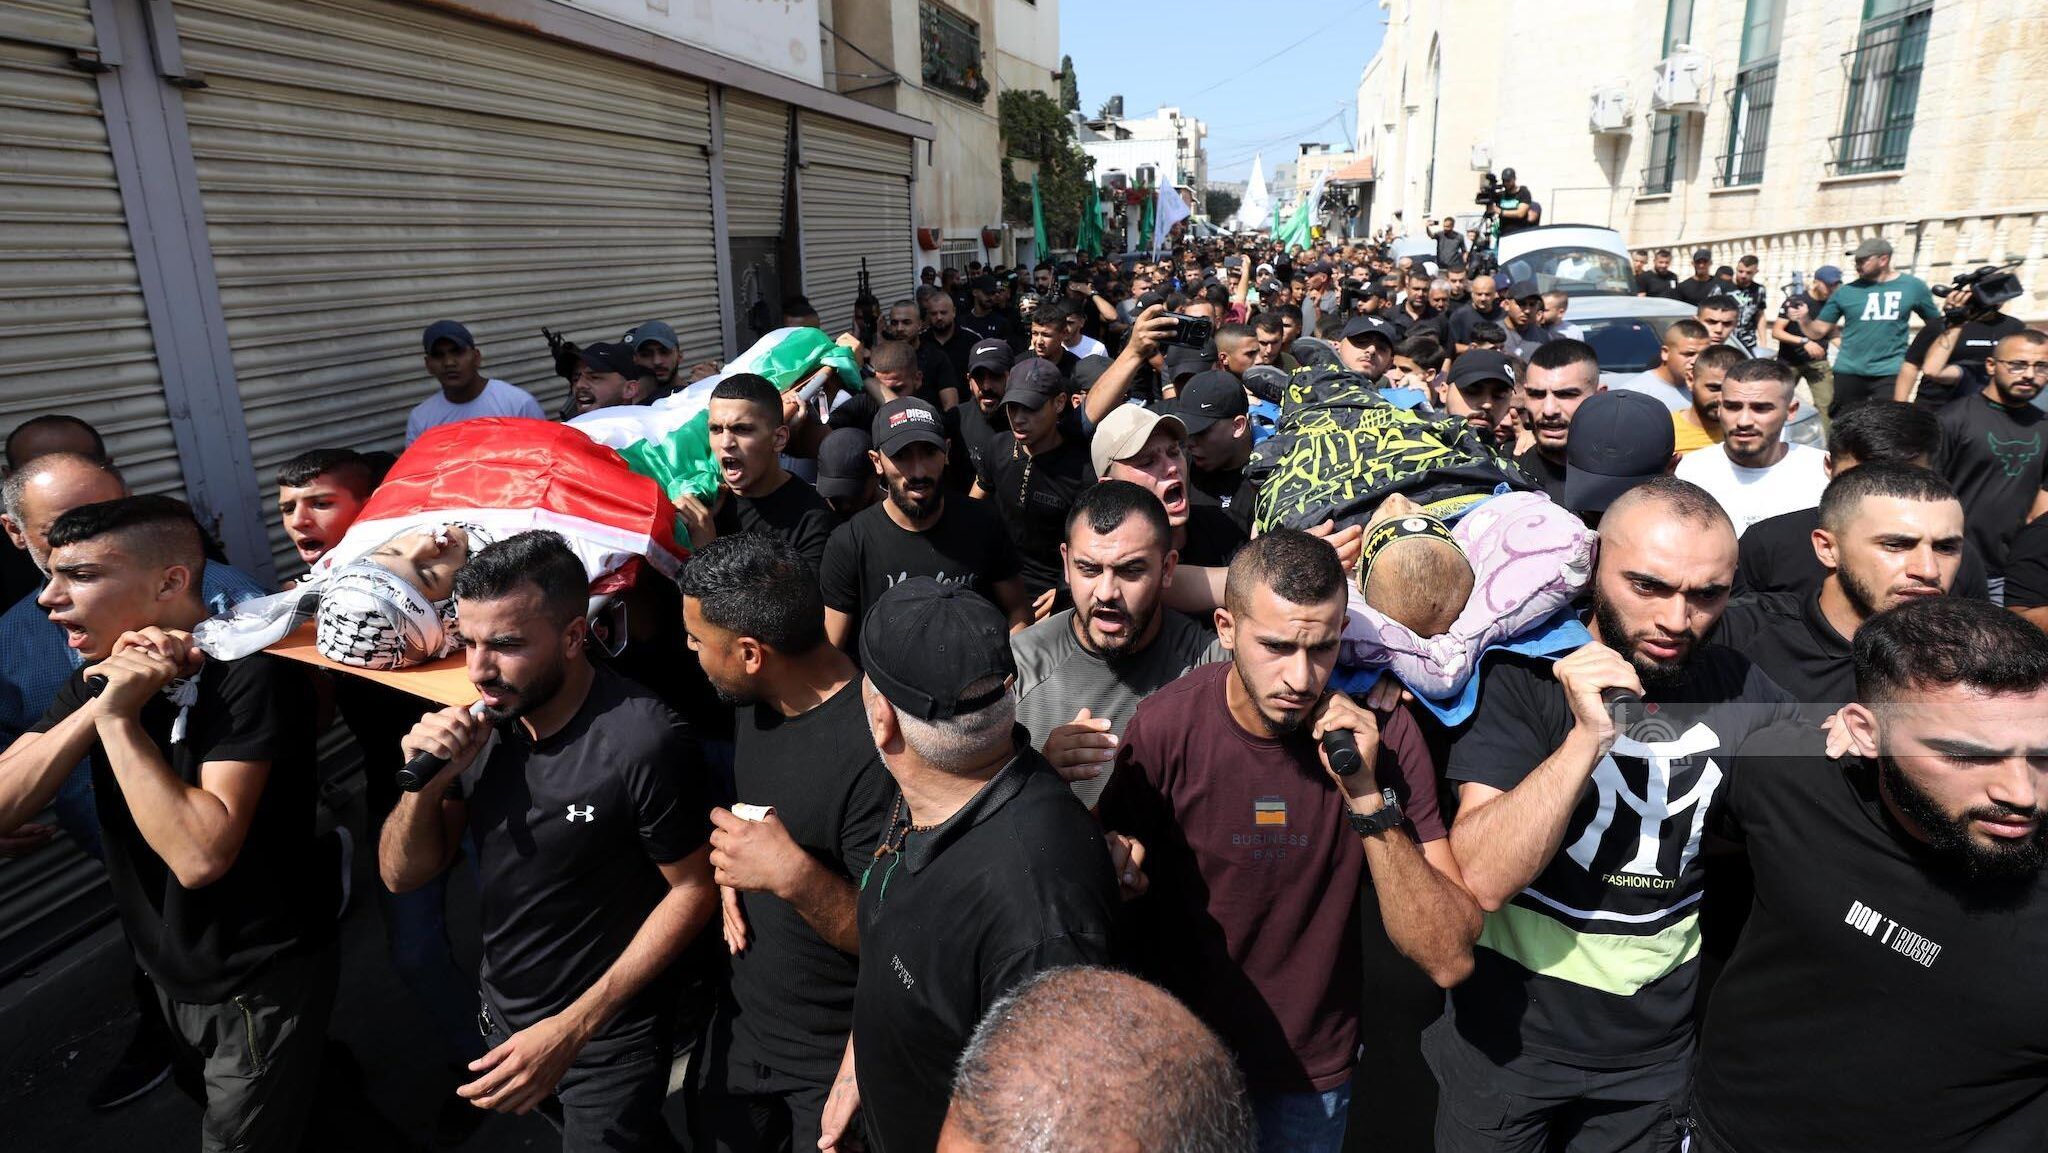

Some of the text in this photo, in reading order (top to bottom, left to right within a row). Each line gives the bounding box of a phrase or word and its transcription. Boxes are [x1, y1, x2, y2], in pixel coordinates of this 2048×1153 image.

[1860, 291, 1902, 321] AE
[1232, 833, 1309, 847] BUSINESS
[1254, 848, 1287, 862] BAG
[1602, 874, 1677, 890] FASHION CITY
[1844, 900, 1943, 968] DON'T RUSH
